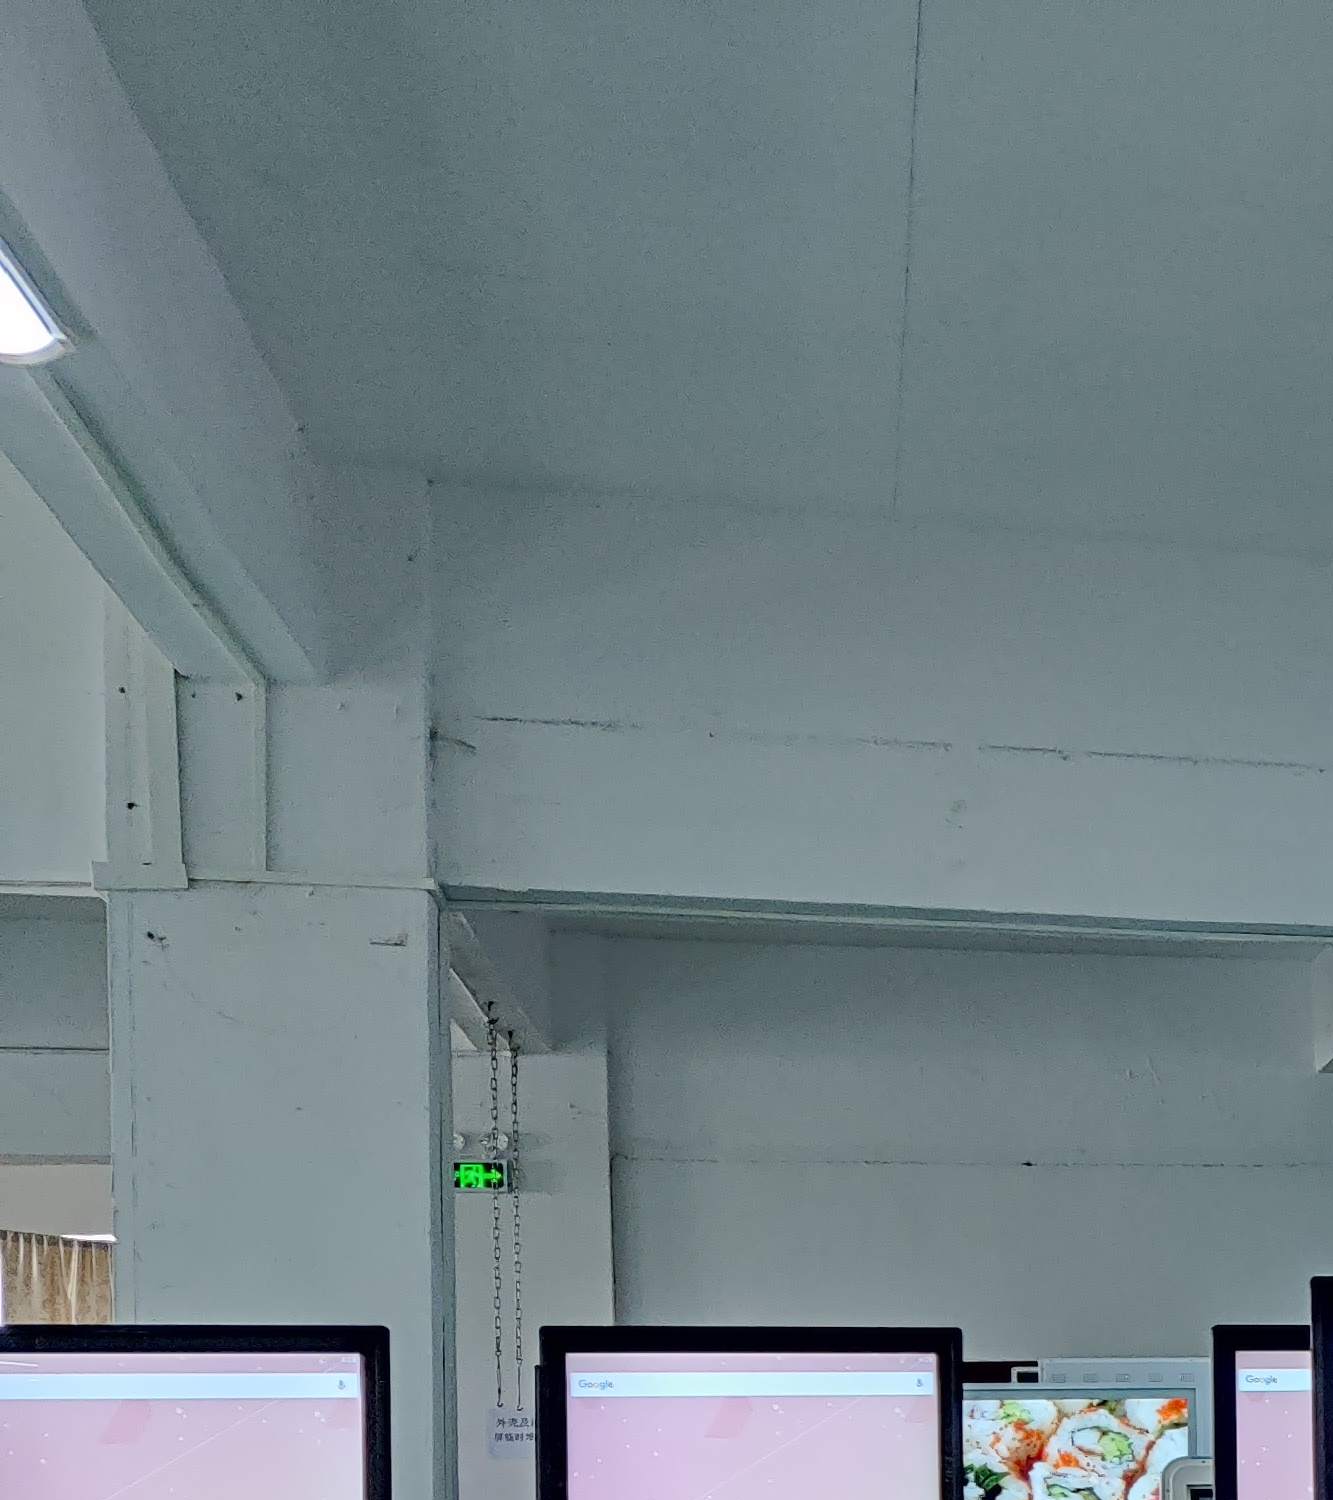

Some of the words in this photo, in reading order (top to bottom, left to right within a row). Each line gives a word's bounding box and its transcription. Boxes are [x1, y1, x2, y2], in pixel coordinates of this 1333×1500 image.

[578, 1379, 614, 1390] Google
[1245, 1374, 1278, 1385] Google
[496, 1417, 533, 1428] 外壳及
